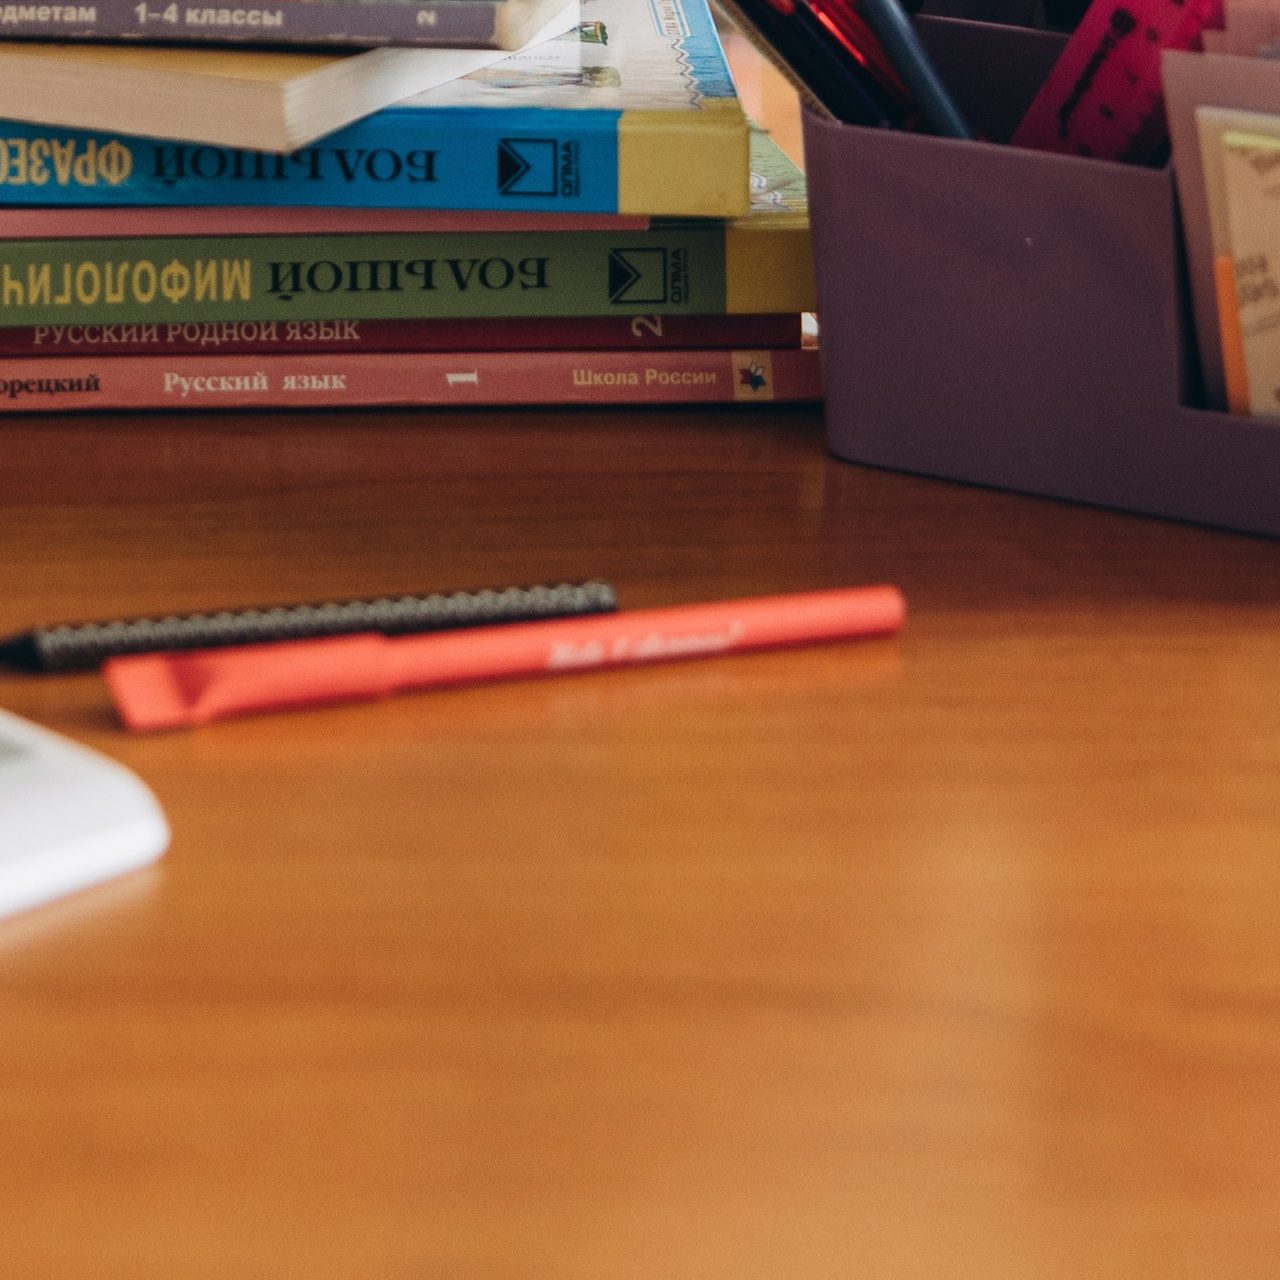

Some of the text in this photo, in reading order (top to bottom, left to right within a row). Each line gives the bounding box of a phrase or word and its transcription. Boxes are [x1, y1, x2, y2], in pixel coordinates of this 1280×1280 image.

[184, 8, 283, 27] классы
[151, 146, 440, 186] БОЛЬШОЙ
[266, 256, 553, 302] БОЛЬШОЙ
[285, 320, 362, 342] ЯЗЫК
[630, 314, 664, 338] 2
[163, 371, 348, 398] Русский язык
[445, 368, 479, 387] 1
[572, 368, 717, 386] Школа России
